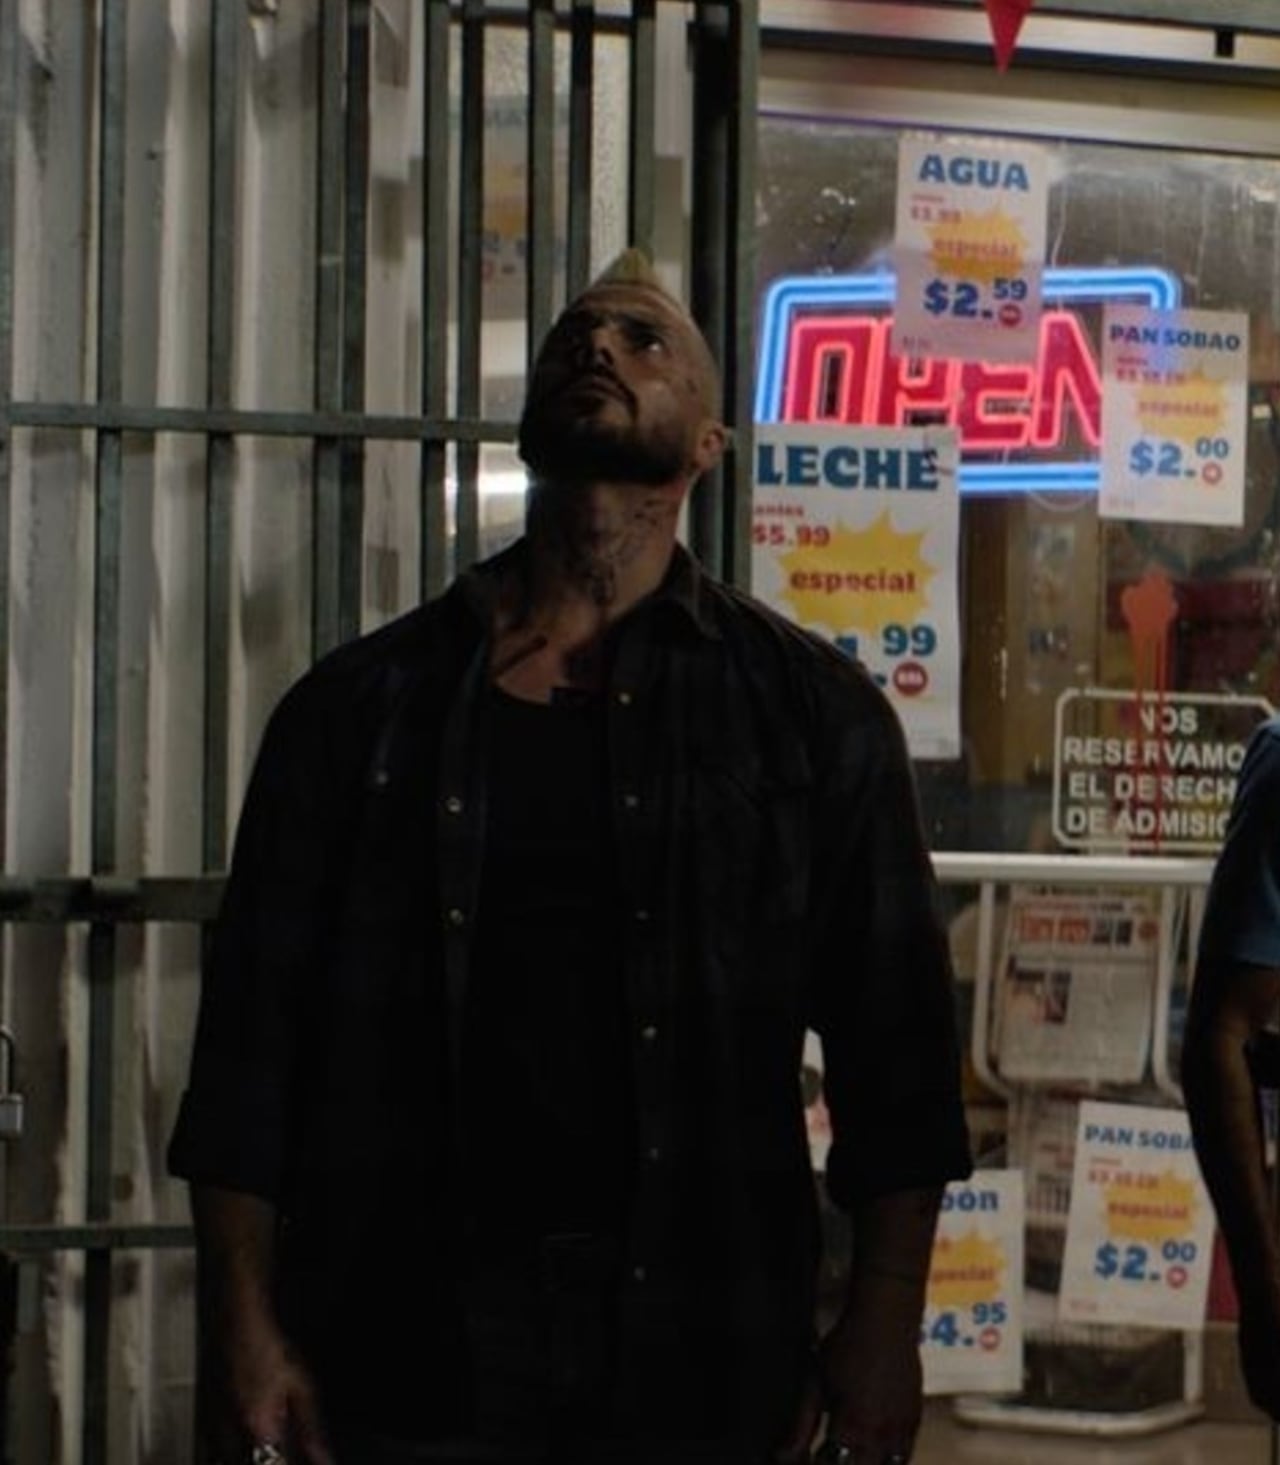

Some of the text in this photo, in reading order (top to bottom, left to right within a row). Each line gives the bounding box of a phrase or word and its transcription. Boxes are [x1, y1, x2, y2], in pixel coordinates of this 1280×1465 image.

[919, 154, 1030, 191] AGUA
[1110, 325, 1240, 352] PAN SOBAO
[757, 445, 939, 491] LECHE
[753, 524, 831, 547] $5.99
[789, 569, 916, 594] especial
[1063, 736, 1247, 771] RESERVAMO
[1069, 772, 1236, 806] EL DERECH
[1066, 807, 1107, 834] DE
[1086, 1126, 1132, 1147] PAN
[920, 1303, 1006, 1347] 4.95
